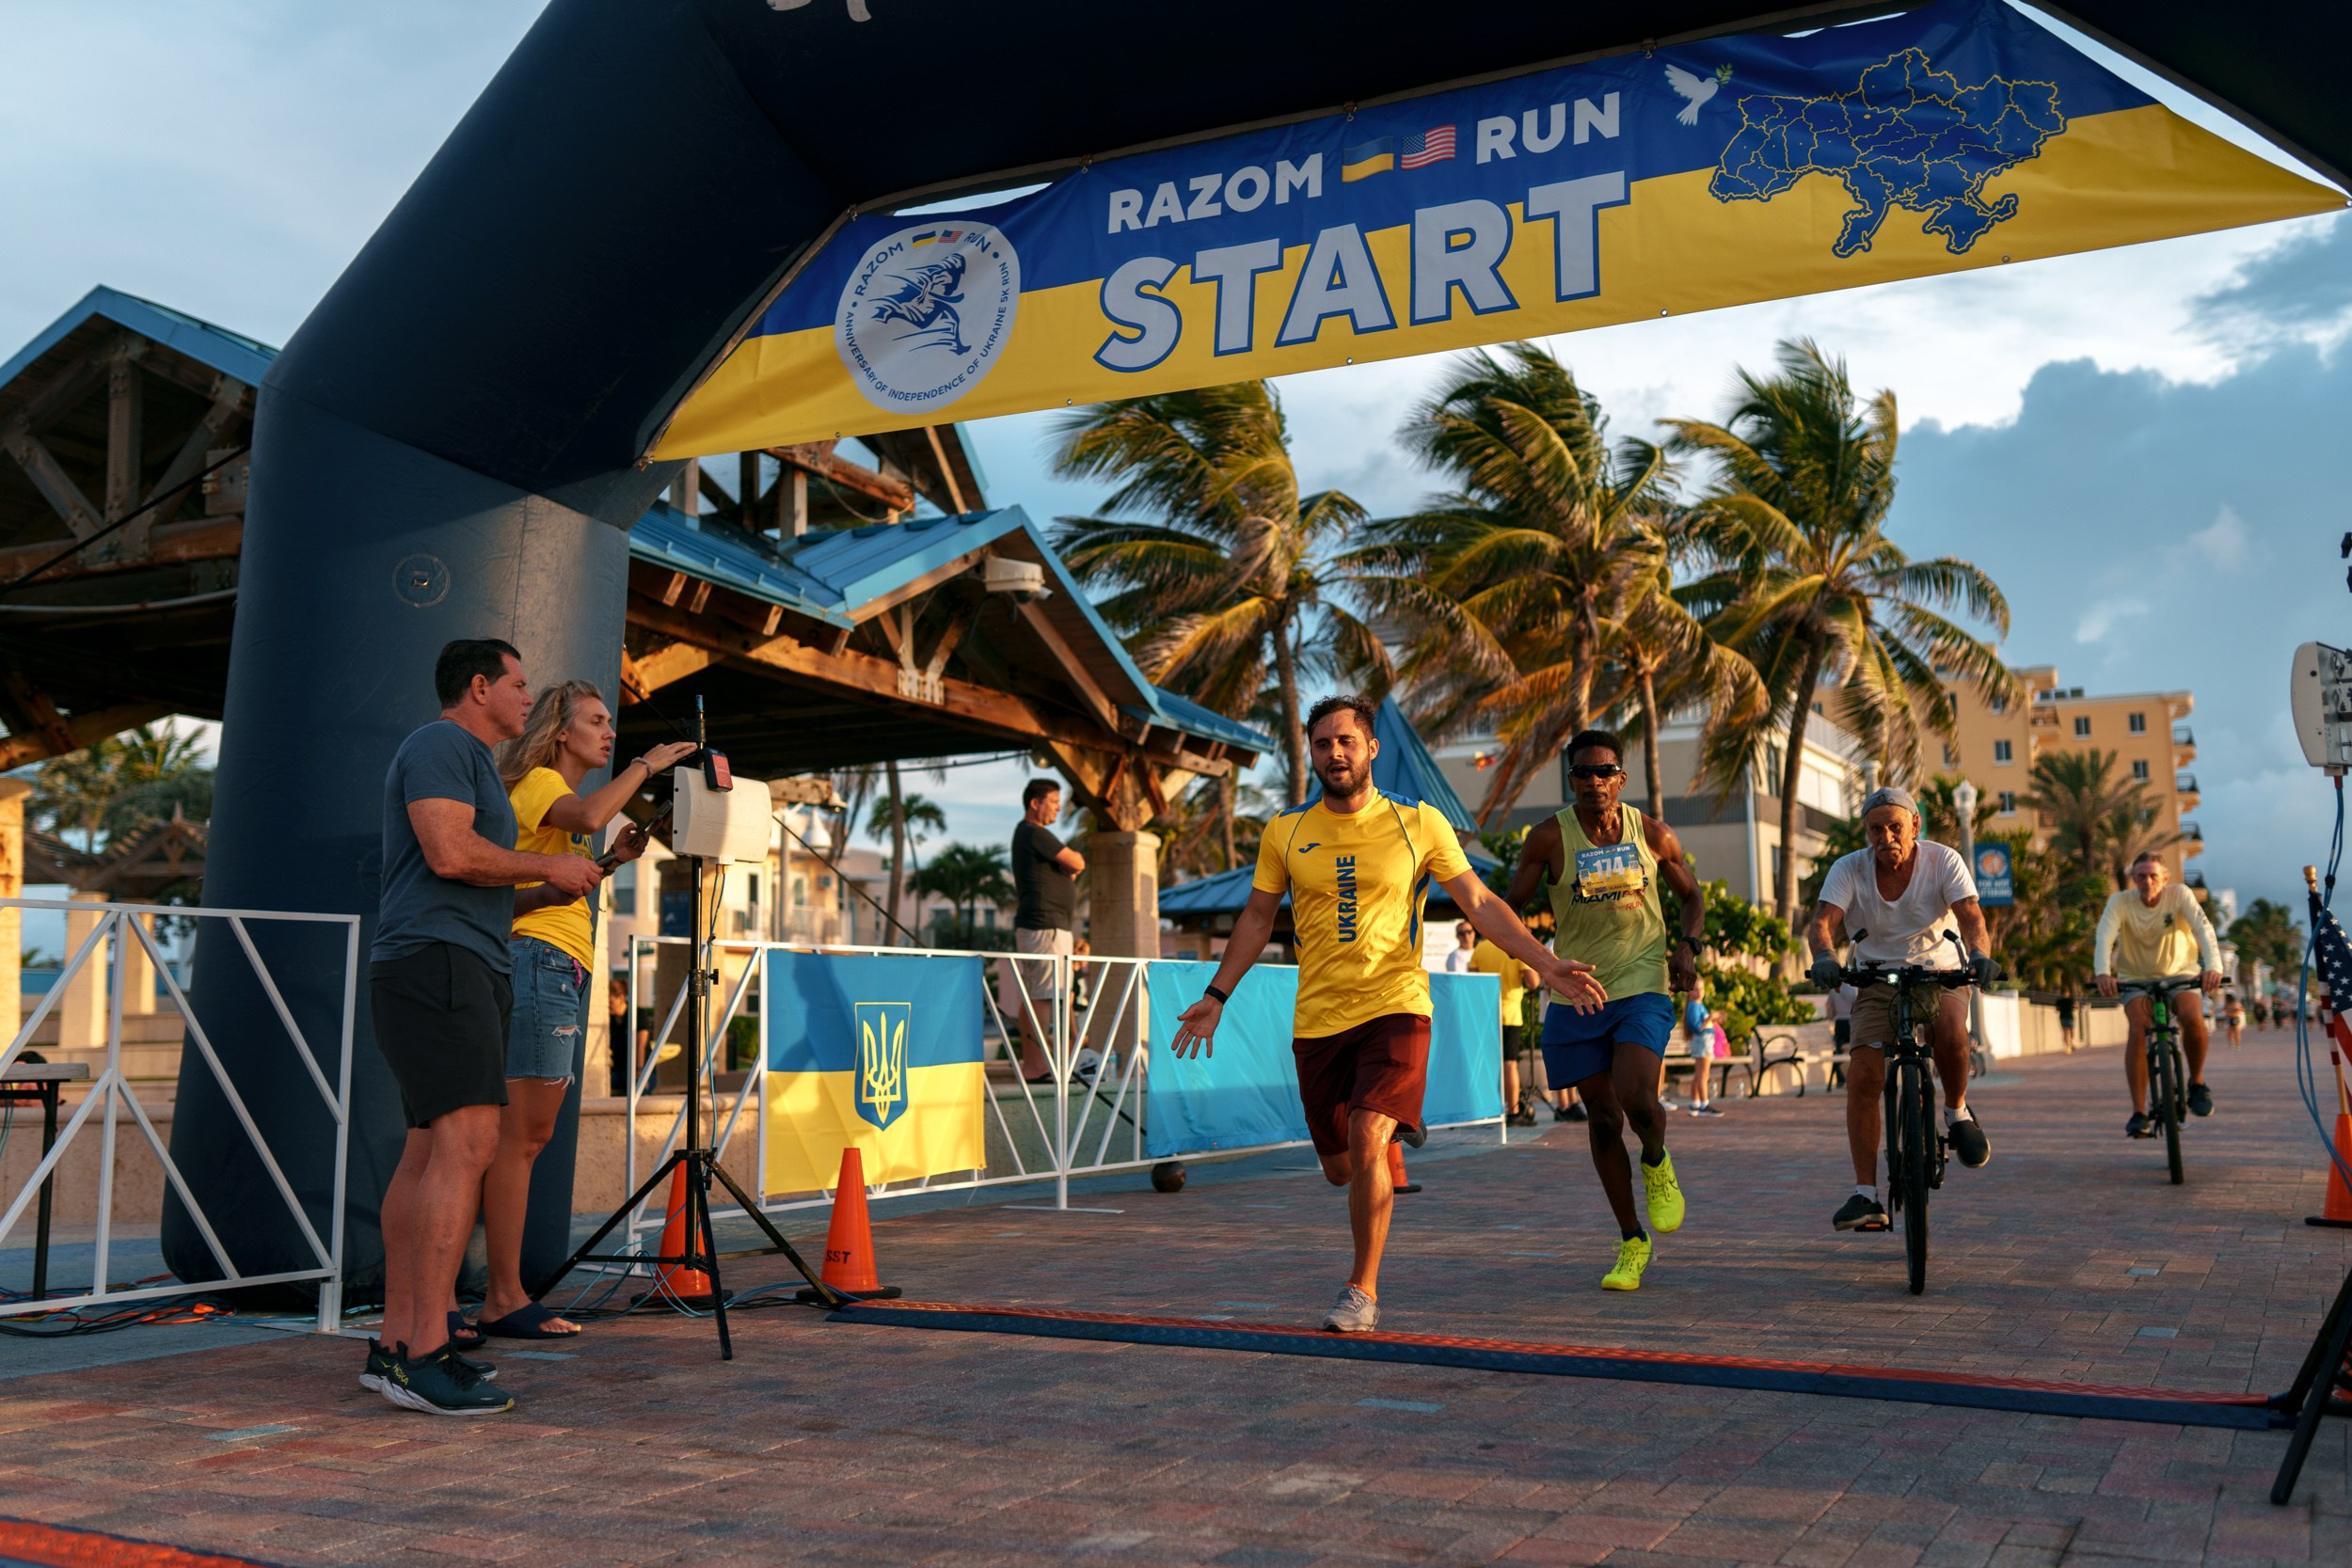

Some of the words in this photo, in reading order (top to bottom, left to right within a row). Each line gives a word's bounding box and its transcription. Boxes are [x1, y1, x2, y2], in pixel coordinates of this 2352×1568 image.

[1107, 151, 1323, 233] RAZOM
[1476, 91, 1621, 166] RUN
[854, 242, 904, 296] RAZOM
[963, 232, 991, 253] RUN
[999, 261, 1010, 286] RUN
[1092, 169, 1631, 373] START
[1000, 288, 1009, 303] 5K
[980, 307, 1007, 357] UKRAINE
[845, 310, 878, 384] ANNIVERSARY
[967, 358, 980, 374] OF
[875, 381, 888, 392] OF
[887, 373, 966, 401] INDEPENDENCE
[1593, 856, 1625, 879] 174
[1336, 855, 1357, 942] UKRAINE
[1572, 892, 1621, 905] MIAMI
[1626, 901, 1643, 911] RUN
[826, 1249, 850, 1264] SST
[392, 1363, 409, 1386] HOKA
